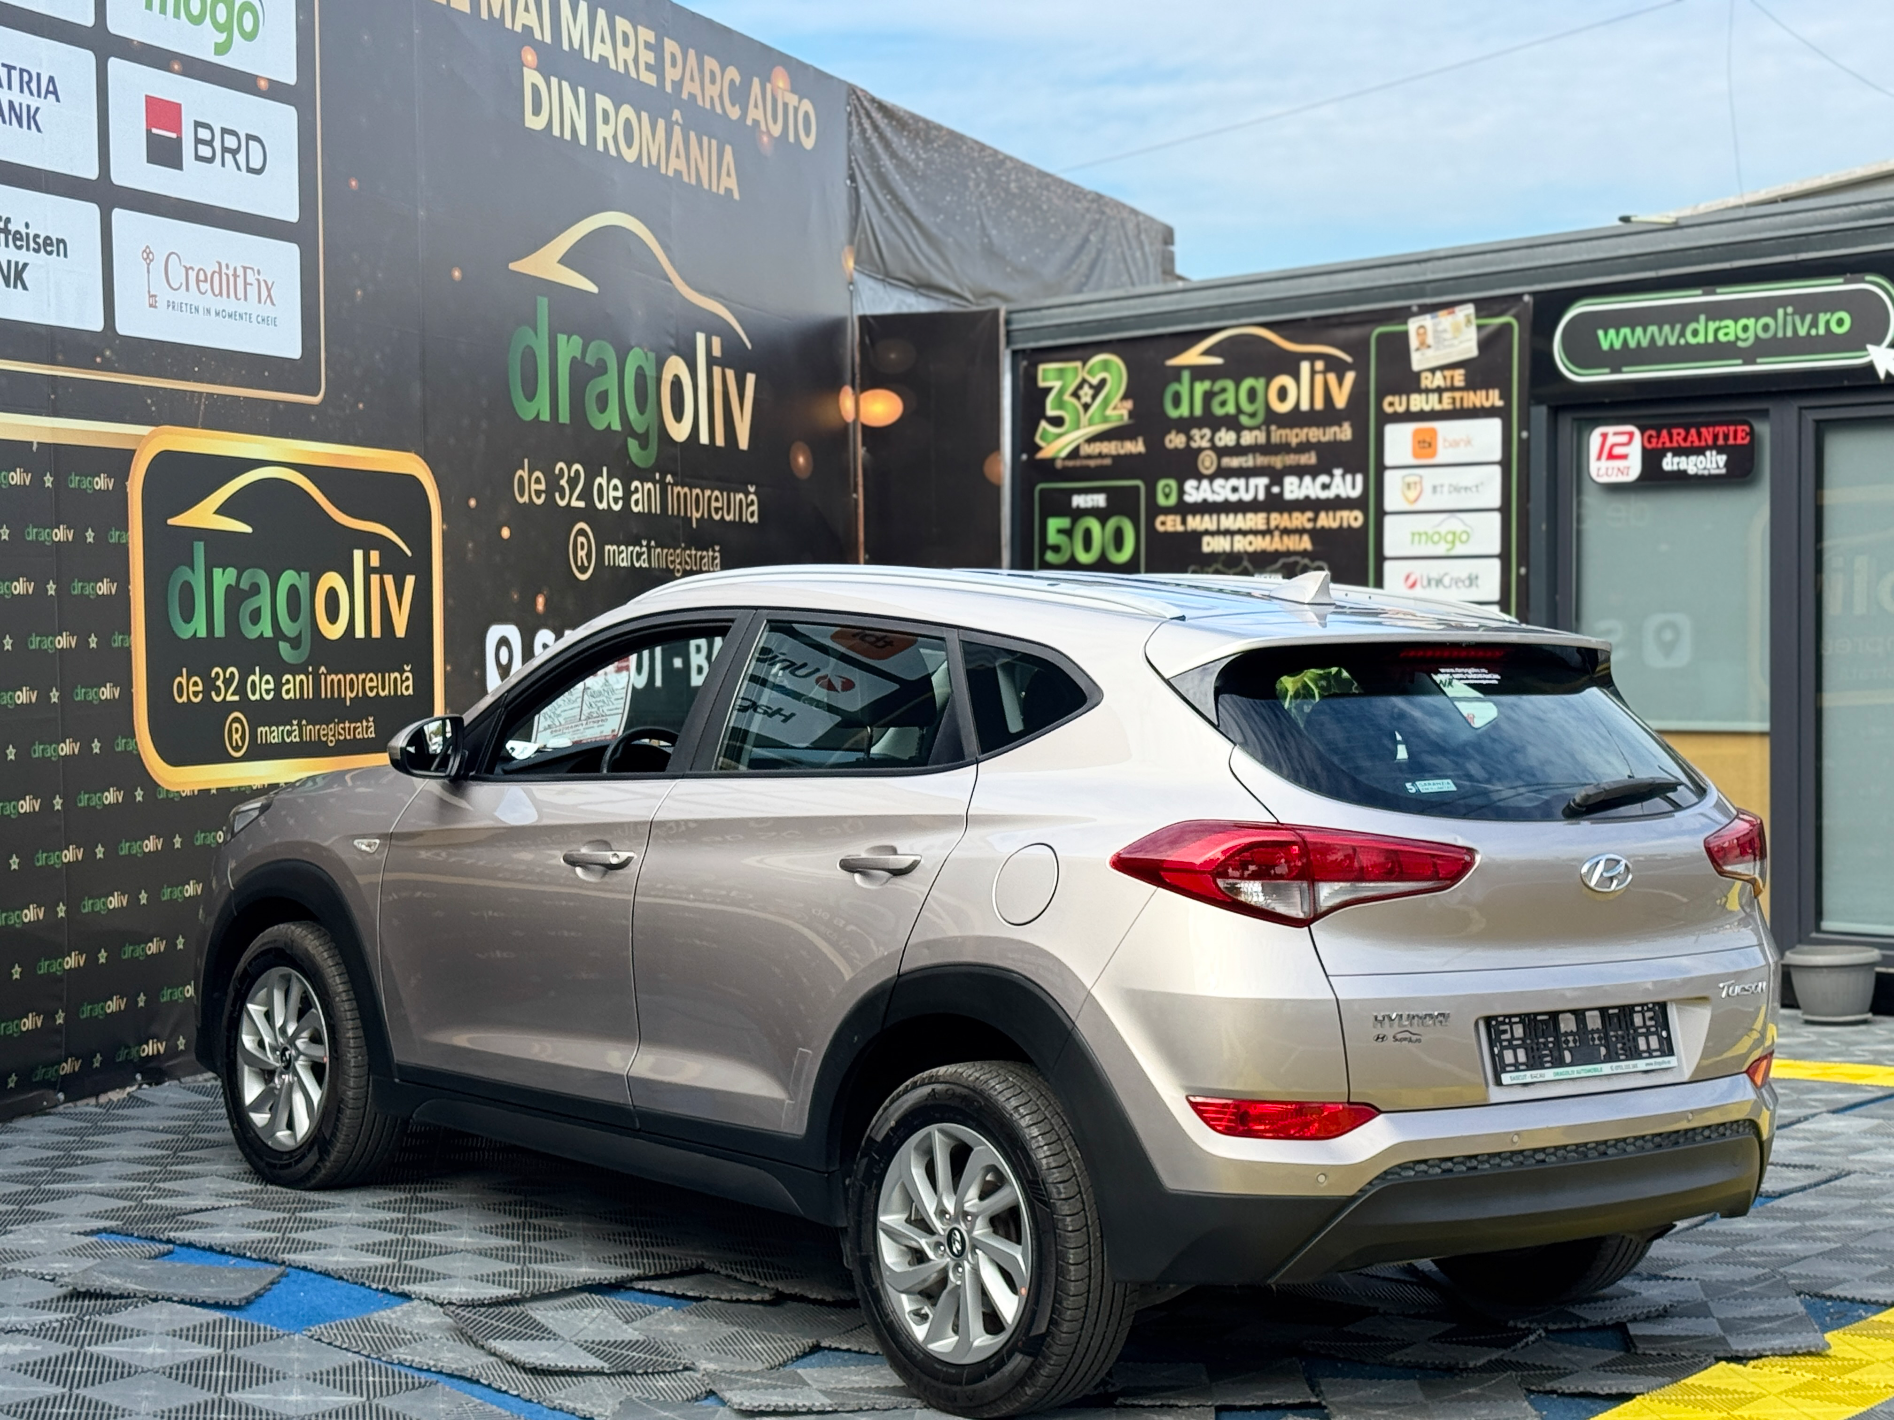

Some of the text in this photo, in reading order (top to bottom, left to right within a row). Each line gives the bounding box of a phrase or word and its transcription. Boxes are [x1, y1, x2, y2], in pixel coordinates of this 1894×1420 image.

[561, 0, 657, 87] MARE
[664, 37, 741, 121] PARC
[746, 76, 818, 151] AUTO
[523, 66, 740, 201] DIN ROMÂNIA
[193, 119, 268, 176] BRD
[164, 251, 276, 307] CreditFix
[166, 300, 278, 327] PRIETEN IN MOMENTE CHEIE
[1597, 306, 1852, 351] www.dragoliv.ro
[508, 296, 756, 468] dragoliv
[1420, 369, 1466, 389] RATE
[1034, 353, 1128, 447] 32
[1163, 360, 1356, 427] dragoliv
[1382, 389, 1504, 413] CU BULETINUL
[1164, 421, 1352, 449] de 32 de ani împreună
[1443, 436, 1473, 449] bank
[1596, 431, 1635, 461] 12
[1642, 425, 1750, 449] GARANTIE
[1596, 467, 1632, 478] LUNI
[1662, 450, 1727, 475] dragoliv
[68, 472, 114, 494] dragoliv
[514, 459, 759, 528] de 32 de ani împreună
[1183, 476, 1270, 503] SASCUT
[1283, 468, 1363, 500] BACĂU
[1071, 494, 1107, 508] PESTE
[25, 524, 74, 545] dragoliv
[1155, 510, 1364, 532] CEL MAI MARE PARC AUTO
[1044, 515, 1136, 565] 500
[1202, 531, 1313, 553] DIN ROMÂNIA
[1411, 530, 1470, 553] mogo
[604, 542, 648, 569] marcă
[650, 542, 721, 576] înregistrată
[71, 578, 117, 599] dragoliv
[1420, 572, 1480, 590] UniCredit
[167, 541, 416, 665] dragoliv
[28, 631, 77, 653] dragoliv
[74, 683, 120, 705] dragoliv
[173, 664, 414, 706] de 32 de ani împreună
[257, 720, 301, 745] marcă
[302, 716, 376, 746] înregistrată
[31, 738, 80, 761] dragoliv
[77, 787, 124, 809] dragoliv
[34, 845, 83, 868] dragoliv
[118, 836, 163, 857] dragoliv
[81, 891, 128, 914] dragoliv
[161, 880, 203, 901] dragoliv
[37, 937, 166, 975] dragoliv dragoliv
[1718, 980, 1766, 998] Tucson
[79, 996, 127, 1019] dragoliv
[1373, 1011, 1450, 1028] HYUNDAI
[32, 1039, 166, 1081] dragoliv dragoliv
